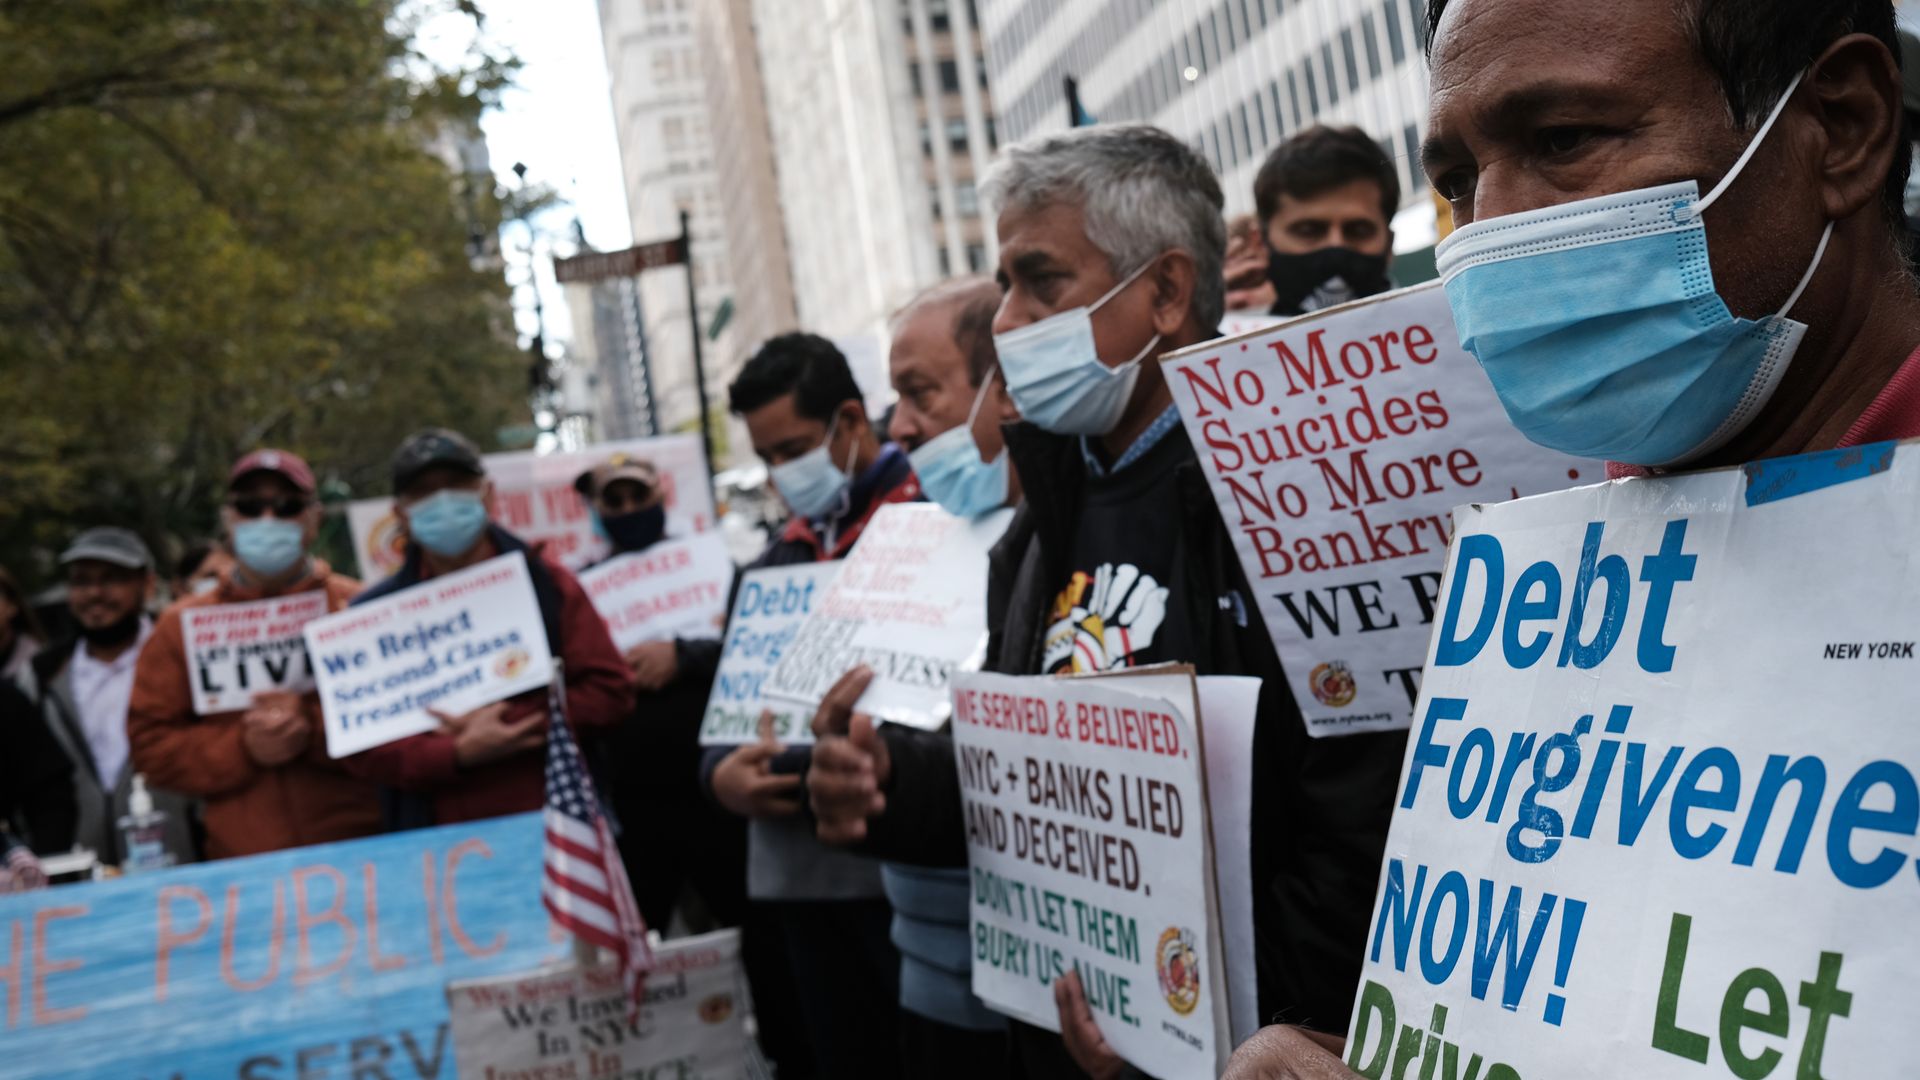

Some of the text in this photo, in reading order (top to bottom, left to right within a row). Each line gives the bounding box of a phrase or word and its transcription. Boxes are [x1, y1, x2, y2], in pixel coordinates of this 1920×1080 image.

[1178, 323, 1438, 418] No More
[1202, 385, 1449, 473] Suicides
[1222, 444, 1482, 527] No More
[1244, 509, 1454, 579] Bankru
[739, 576, 816, 618] Debt
[1274, 581, 1398, 640] WE
[1434, 518, 1698, 674] Debt
[200, 653, 314, 692] LIV
[322, 608, 473, 677] We Reject
[1823, 641, 1917, 660] NEW YORK
[339, 666, 483, 732] Treatment
[706, 704, 792, 737] Drivrs
[953, 687, 1189, 760] WE SERVED & BELIEVED.
[959, 743, 1184, 839] NYC + BANKS LIED
[1401, 697, 1920, 890] Forgivene
[967, 800, 1152, 896] AND DECEIVED.
[155, 837, 508, 1004] PUBLIC
[973, 866, 1141, 965] DON'T LET THEM
[975, 919, 1030, 979] BURY
[1371, 858, 1854, 1080] NOW! Let
[502, 1004, 559, 1031] We
[536, 1010, 655, 1056] In NYC
[1347, 979, 1523, 1080] Driv
[586, 1049, 623, 1075] In
